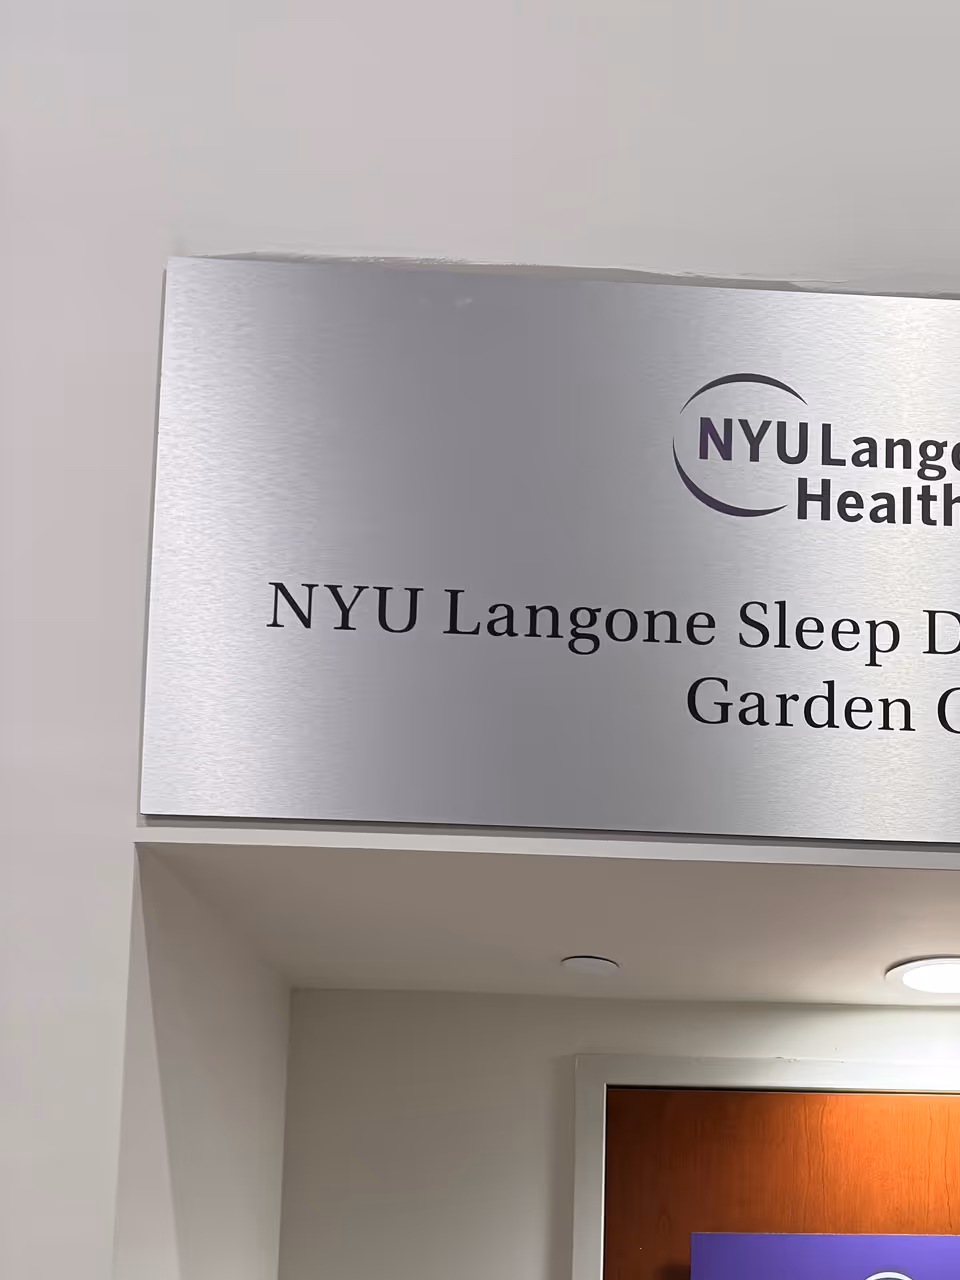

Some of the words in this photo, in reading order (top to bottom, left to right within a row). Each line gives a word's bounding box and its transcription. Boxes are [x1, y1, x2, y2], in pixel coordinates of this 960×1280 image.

[697, 418, 812, 464] NYU
[266, 583, 424, 633] NYU
[443, 589, 716, 655] Langone
[738, 603, 901, 666] Sleep
[687, 678, 914, 732] Garden
